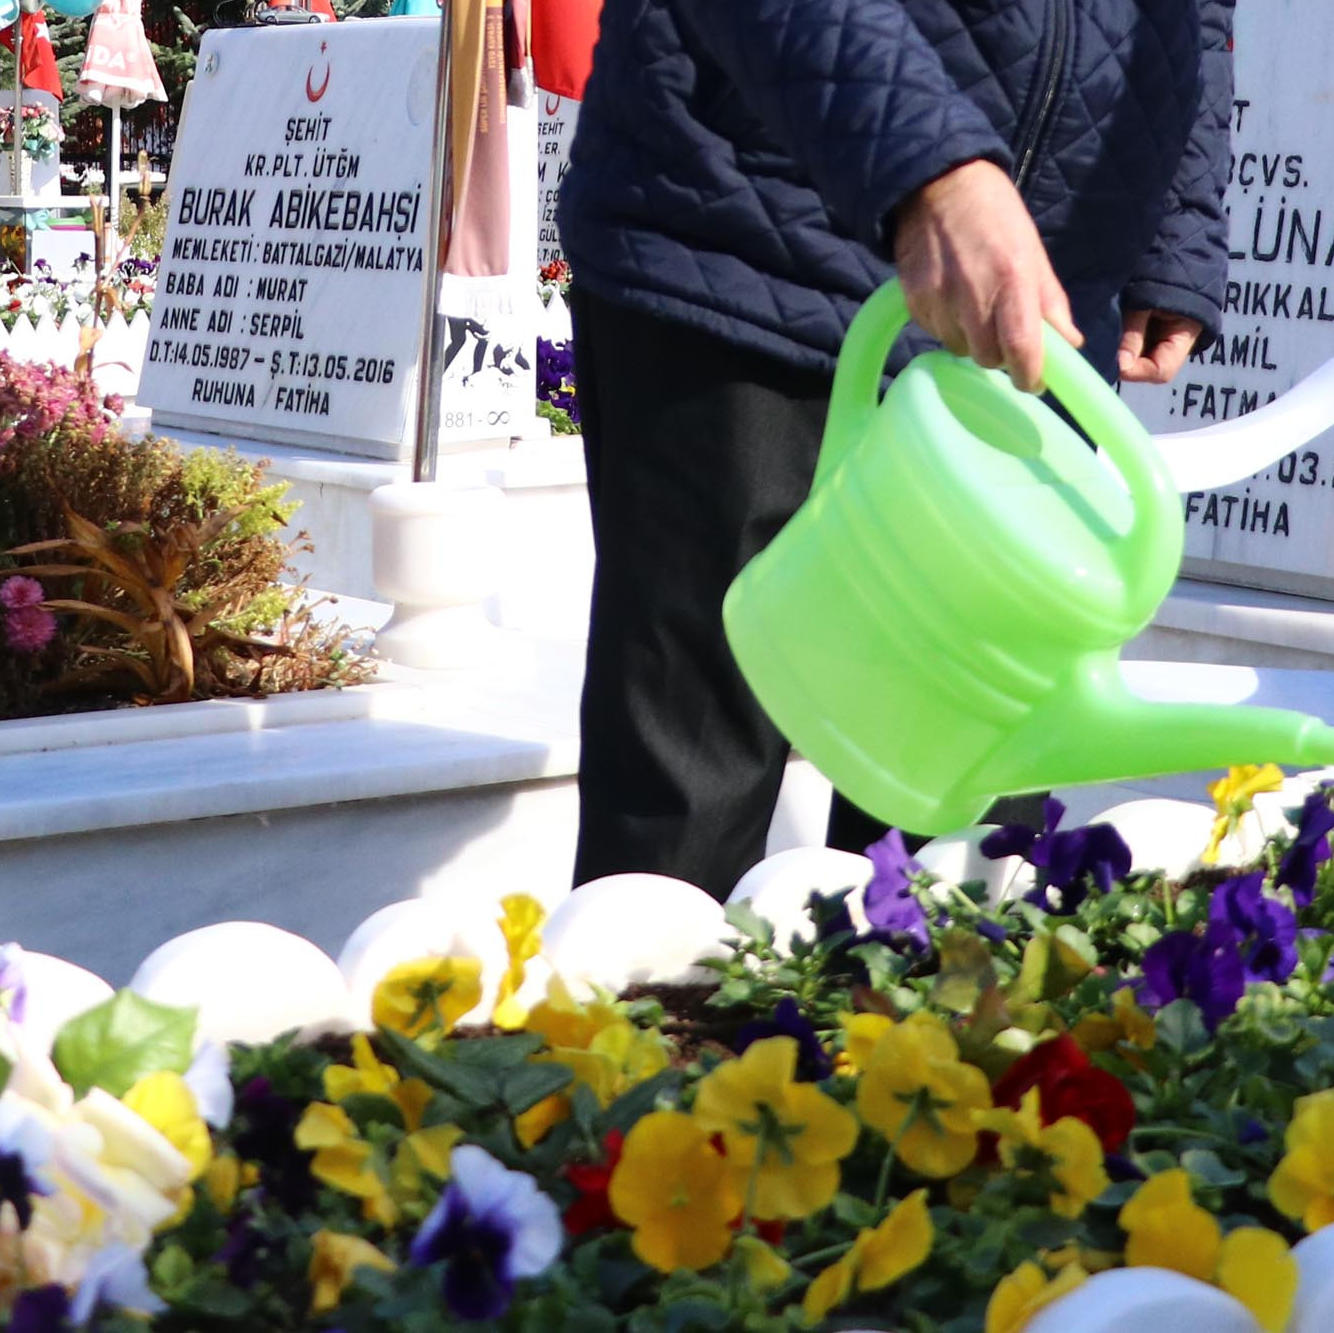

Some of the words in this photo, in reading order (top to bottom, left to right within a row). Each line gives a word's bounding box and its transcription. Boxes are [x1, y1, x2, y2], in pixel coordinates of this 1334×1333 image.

[284, 112, 333, 147] ŞEHİT
[177, 186, 257, 228] BURAK
[268, 183, 422, 241] ABİKEBAHŞİ
[165, 271, 205, 297] BABA
[213, 274, 239, 298] ADI
[160, 306, 201, 332] ANNE
[206, 308, 233, 334] ADI
[191, 377, 256, 409] RUHUNA
[274, 382, 331, 416] FATİHA
[1185, 487, 1290, 537] FATİHA
